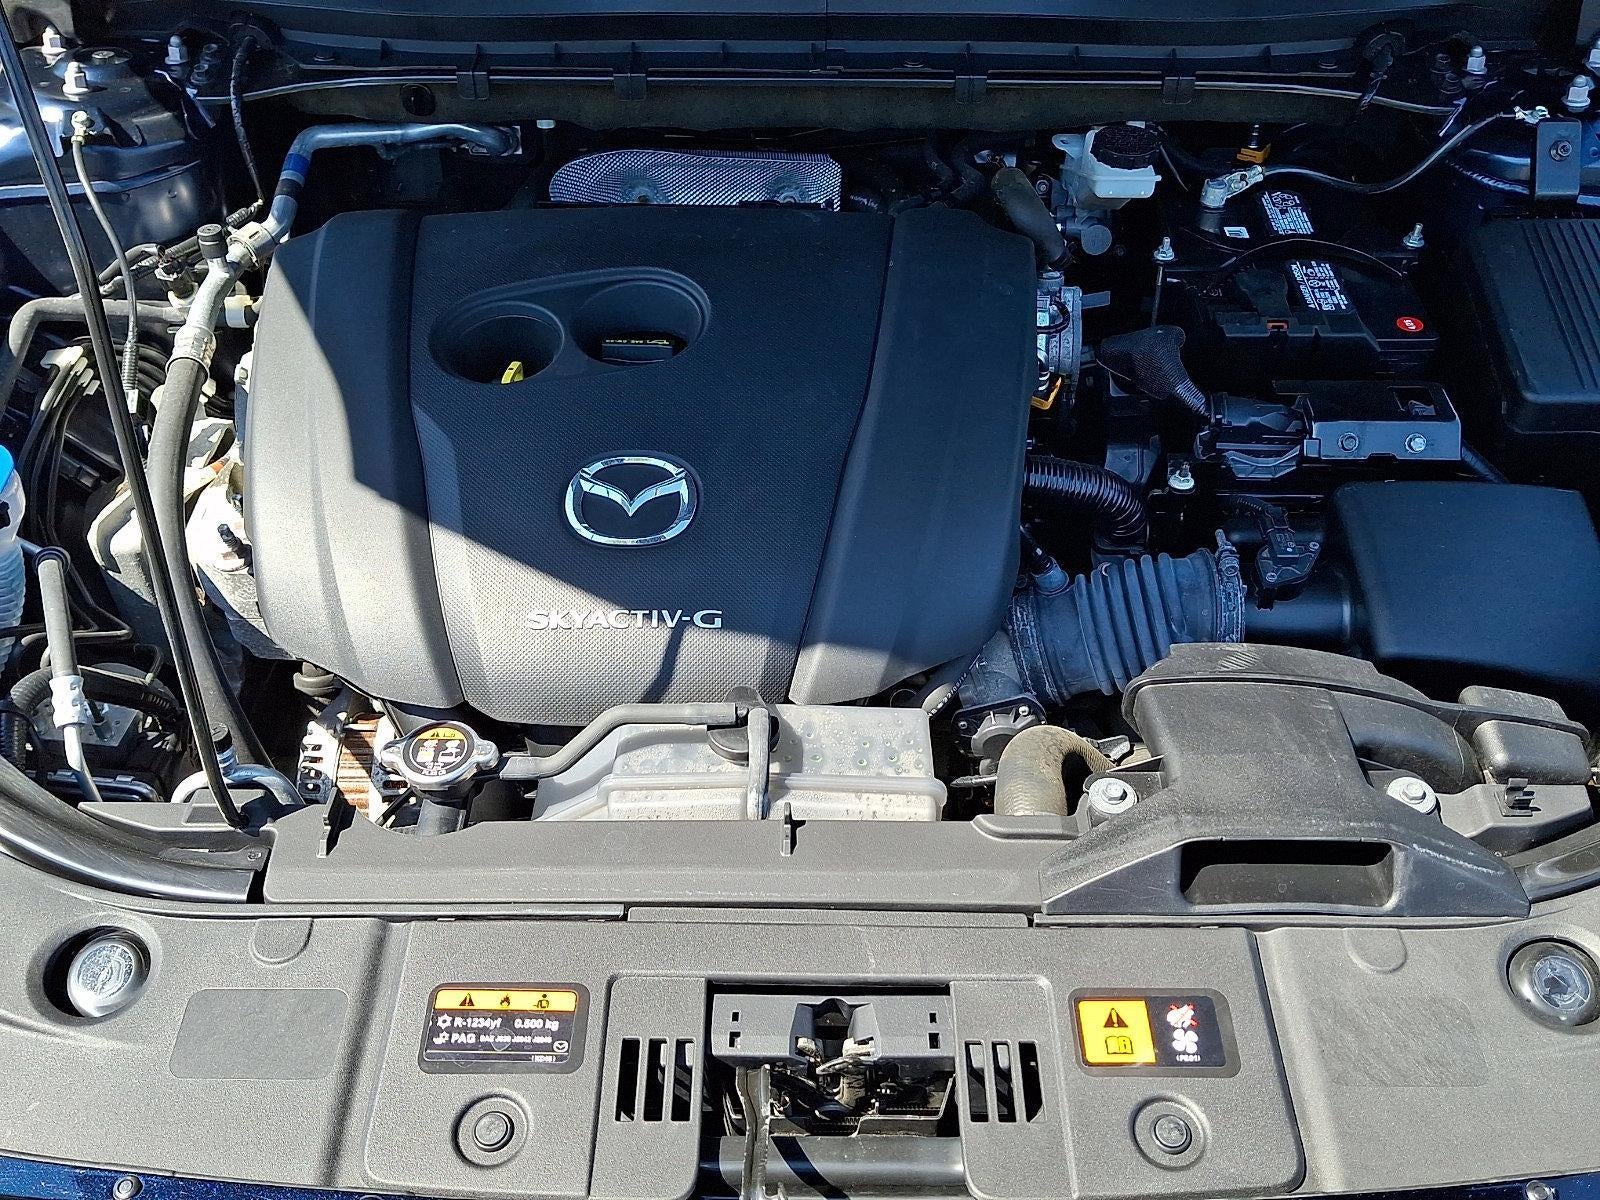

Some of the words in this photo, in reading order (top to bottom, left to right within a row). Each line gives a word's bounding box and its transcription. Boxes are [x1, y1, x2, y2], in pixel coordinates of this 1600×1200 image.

[529, 609, 723, 630] SKYACTIV-G
[545, 1018, 560, 1032] kg
[450, 1033, 476, 1044] PAG
